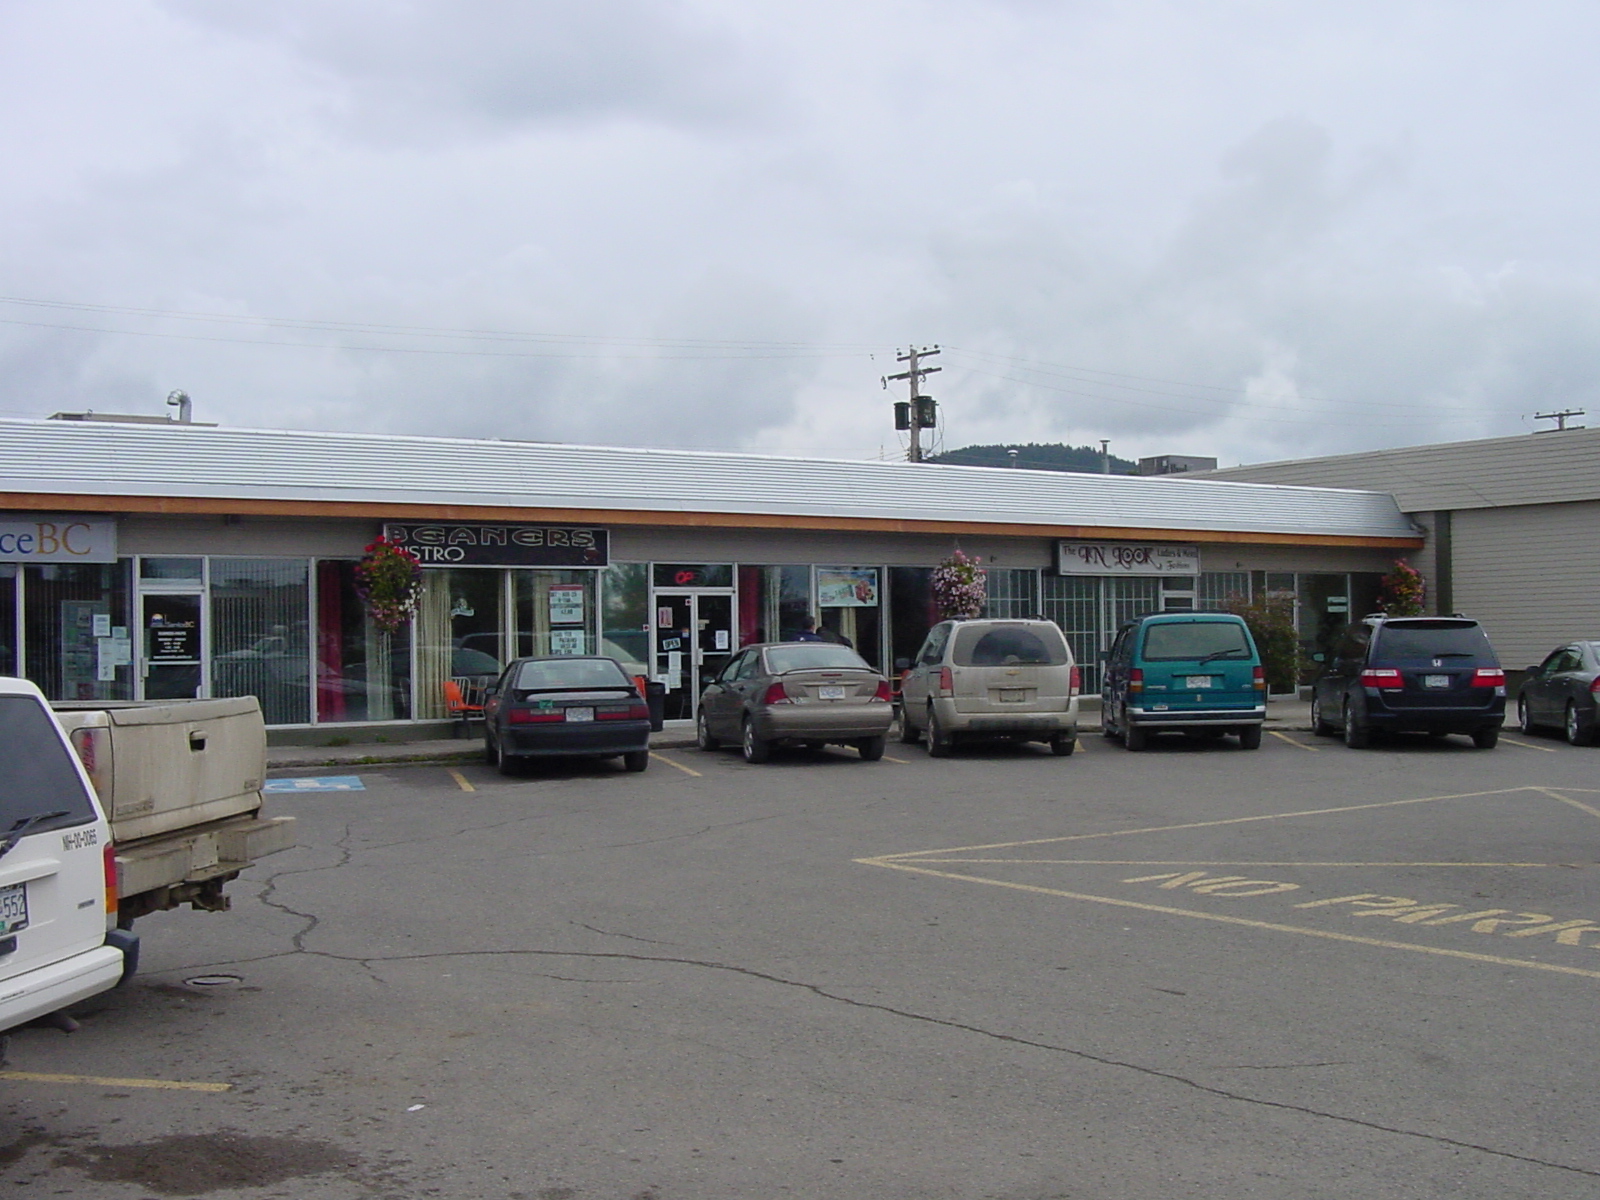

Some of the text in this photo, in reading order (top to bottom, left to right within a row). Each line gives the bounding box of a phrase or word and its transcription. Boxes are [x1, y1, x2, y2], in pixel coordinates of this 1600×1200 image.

[0, 523, 91, 555] ceBC
[386, 525, 594, 547] BEANERS
[1120, 871, 1600, 949] NO PARK
